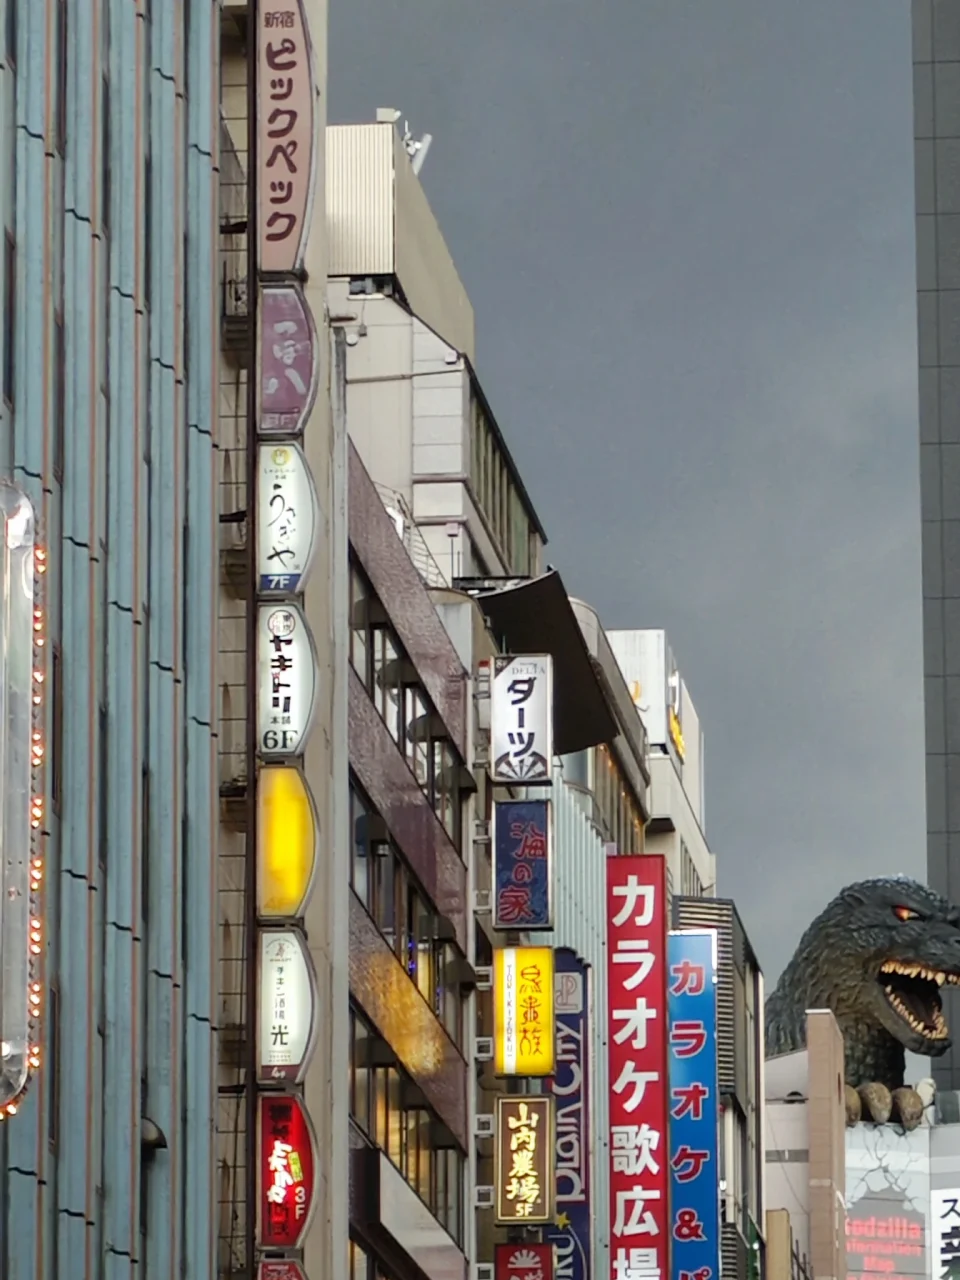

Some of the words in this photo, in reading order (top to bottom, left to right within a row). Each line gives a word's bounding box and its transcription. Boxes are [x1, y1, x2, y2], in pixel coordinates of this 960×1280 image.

[264, 10, 295, 28] 新宿
[267, 576, 291, 588] 7F
[507, 676, 537, 758] ダーツ
[262, 730, 298, 750] 6F
[518, 964, 543, 1056] 鳥貴族
[270, 1025, 289, 1046] 光
[506, 1102, 540, 1204] 山内農場
